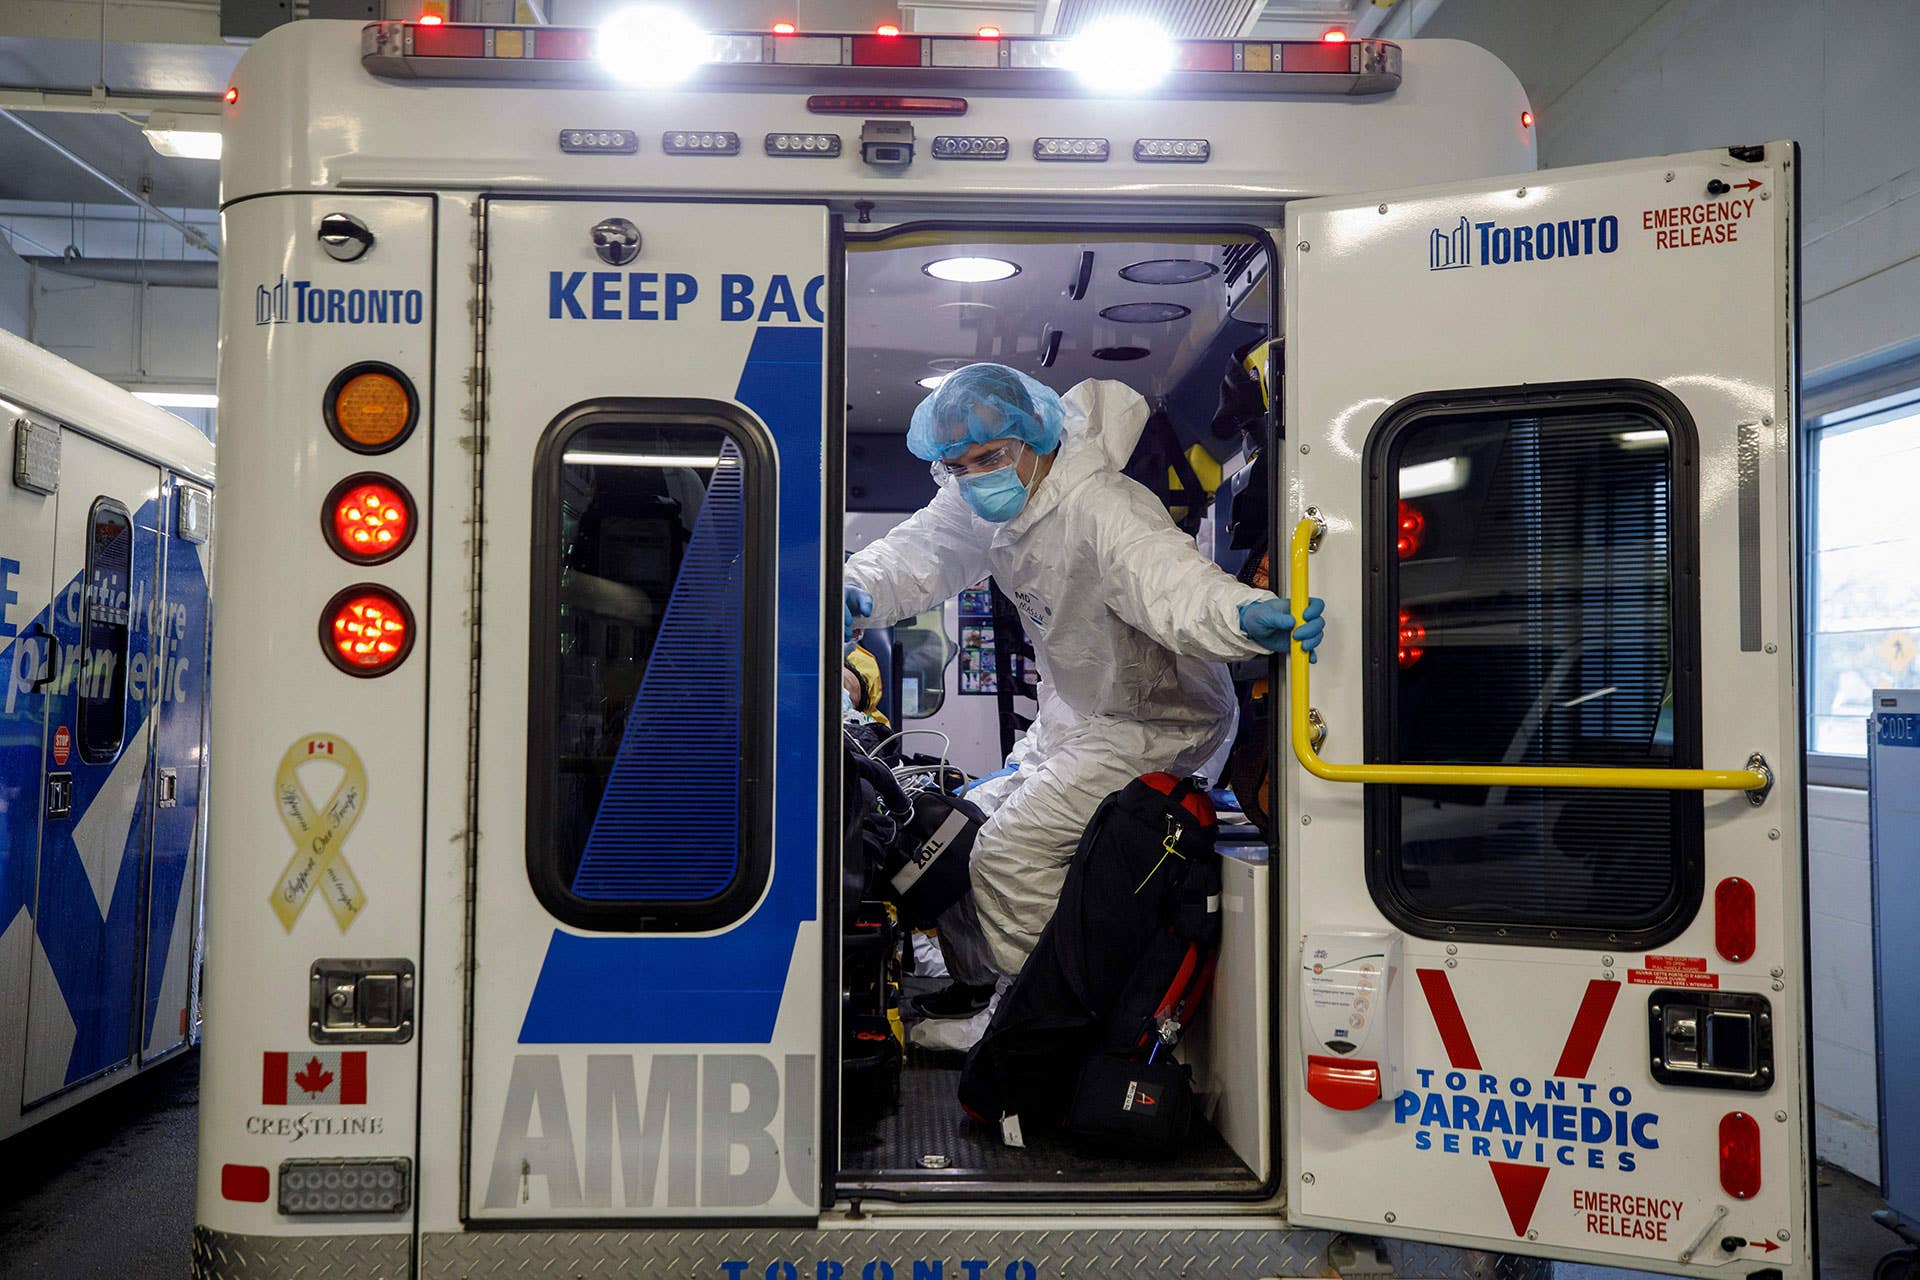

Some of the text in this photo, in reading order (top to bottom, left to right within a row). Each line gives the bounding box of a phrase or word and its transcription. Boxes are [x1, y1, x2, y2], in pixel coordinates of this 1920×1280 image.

[1642, 199, 1755, 230] EMERGENCY
[1475, 215, 1619, 266] TORONTO
[1656, 223, 1738, 250] RELEASE
[293, 280, 423, 325] TORONTO
[549, 271, 698, 321] KEEP
[55, 734, 69, 747] STOP
[1881, 717, 1912, 739] CODE
[1416, 1069, 1632, 1106] TORONTO
[246, 1111, 385, 1143] CRESTLINE
[1393, 1089, 1660, 1149] PARAMEDIC
[1415, 1131, 1637, 1172] SERVICES
[1573, 1190, 1684, 1221] EMERGENCY
[1586, 1213, 1668, 1242] RELEASE
[720, 1260, 1037, 1280] TORONTO
